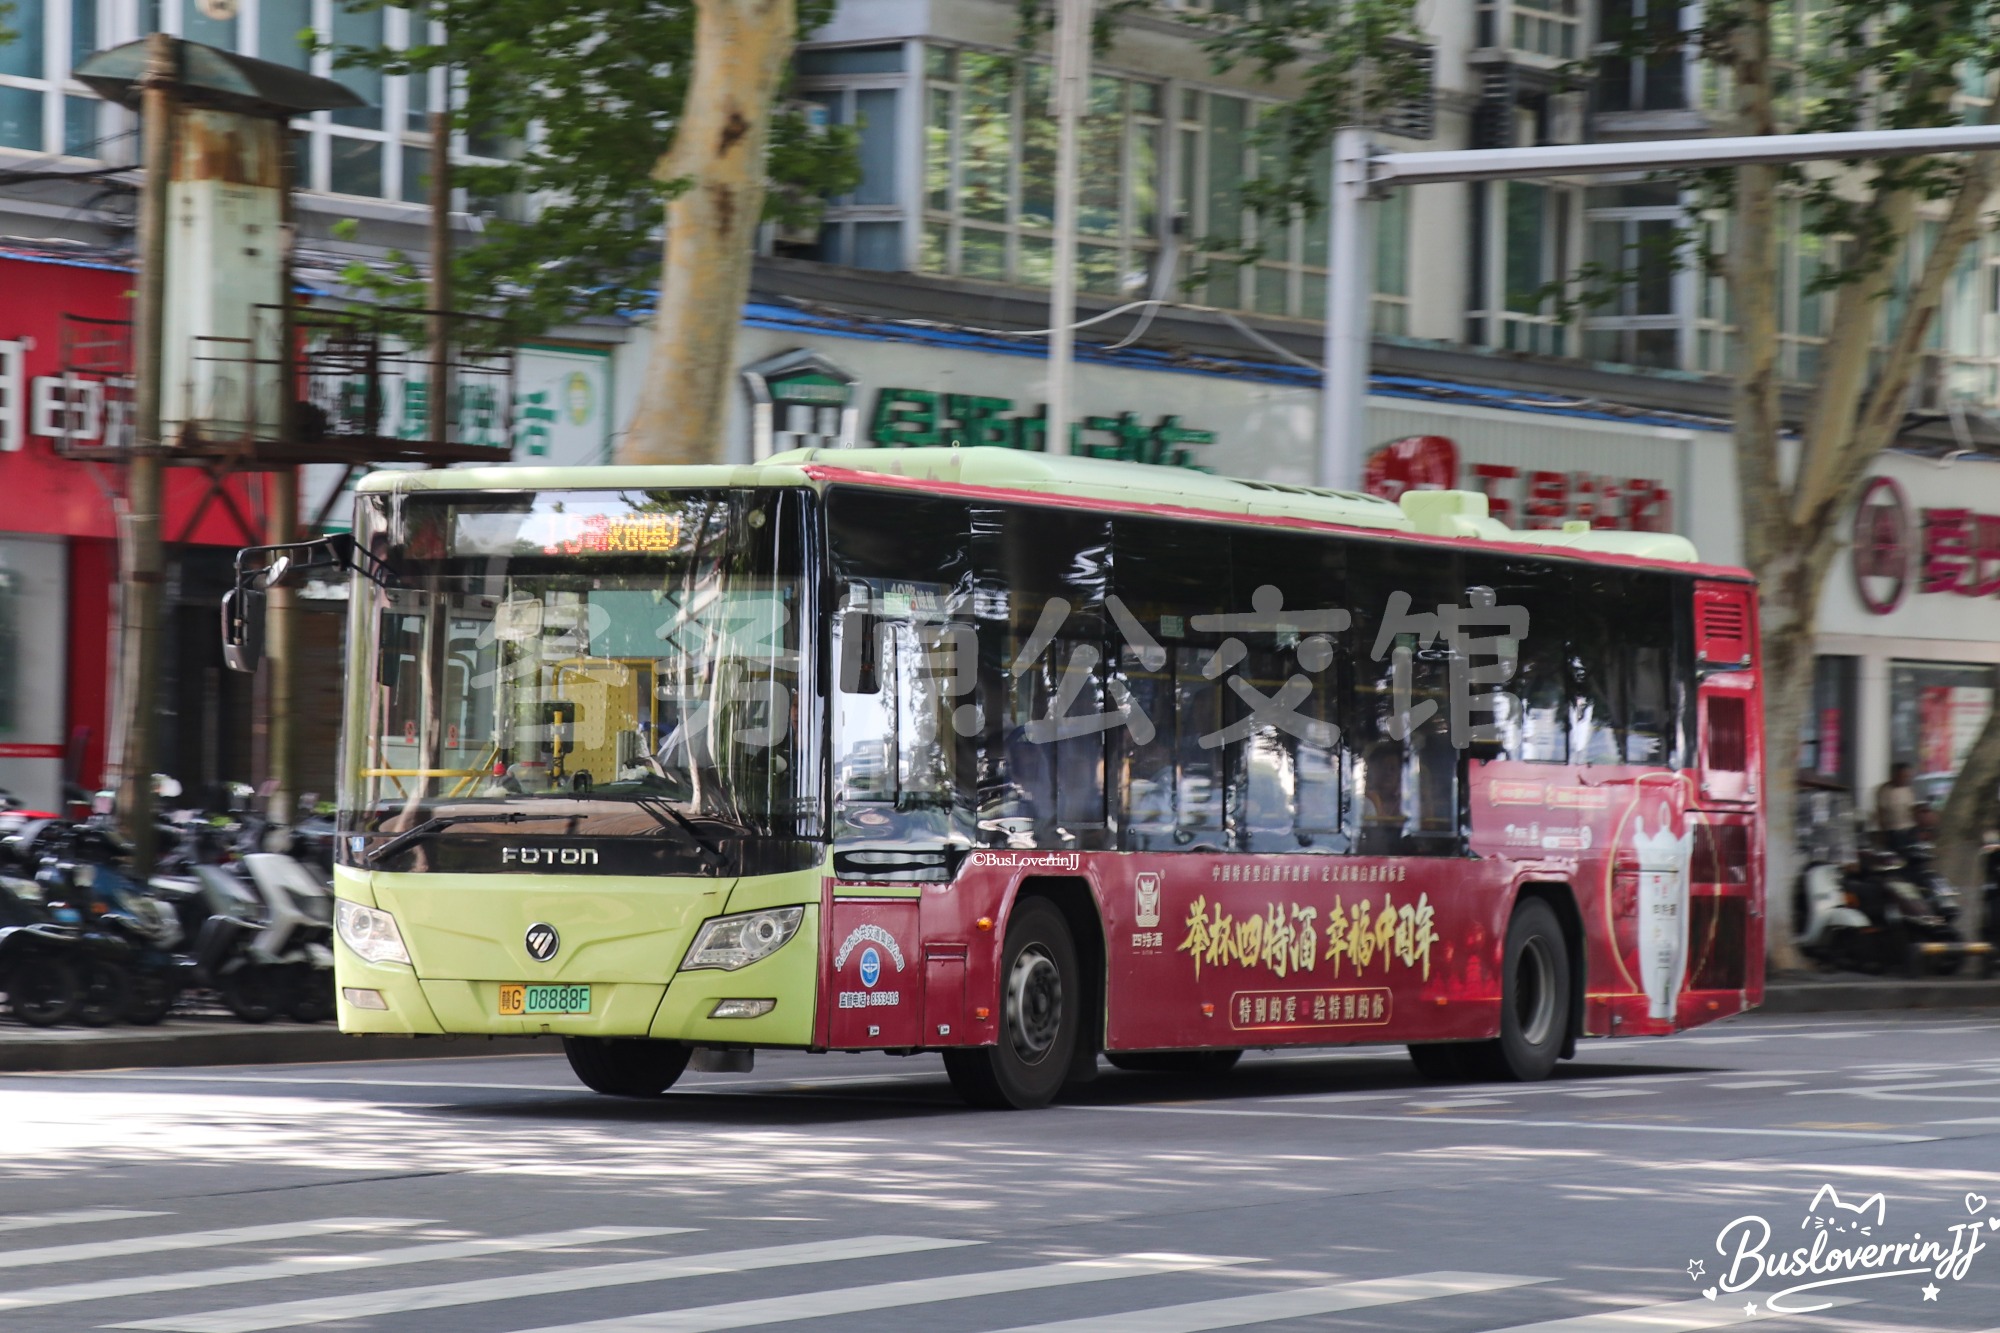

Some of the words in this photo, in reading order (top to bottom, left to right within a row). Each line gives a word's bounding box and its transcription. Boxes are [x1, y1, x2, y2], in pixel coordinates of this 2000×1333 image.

[502, 847, 598, 864] FOTON
[1132, 932, 1163, 947] 四特酒
[1176, 894, 1317, 983] 举杯四特酒
[1325, 892, 1439, 983] 幸福中国年
[1239, 996, 1297, 1023] 特别的爱
[1313, 994, 1384, 1020] 给特别的你
